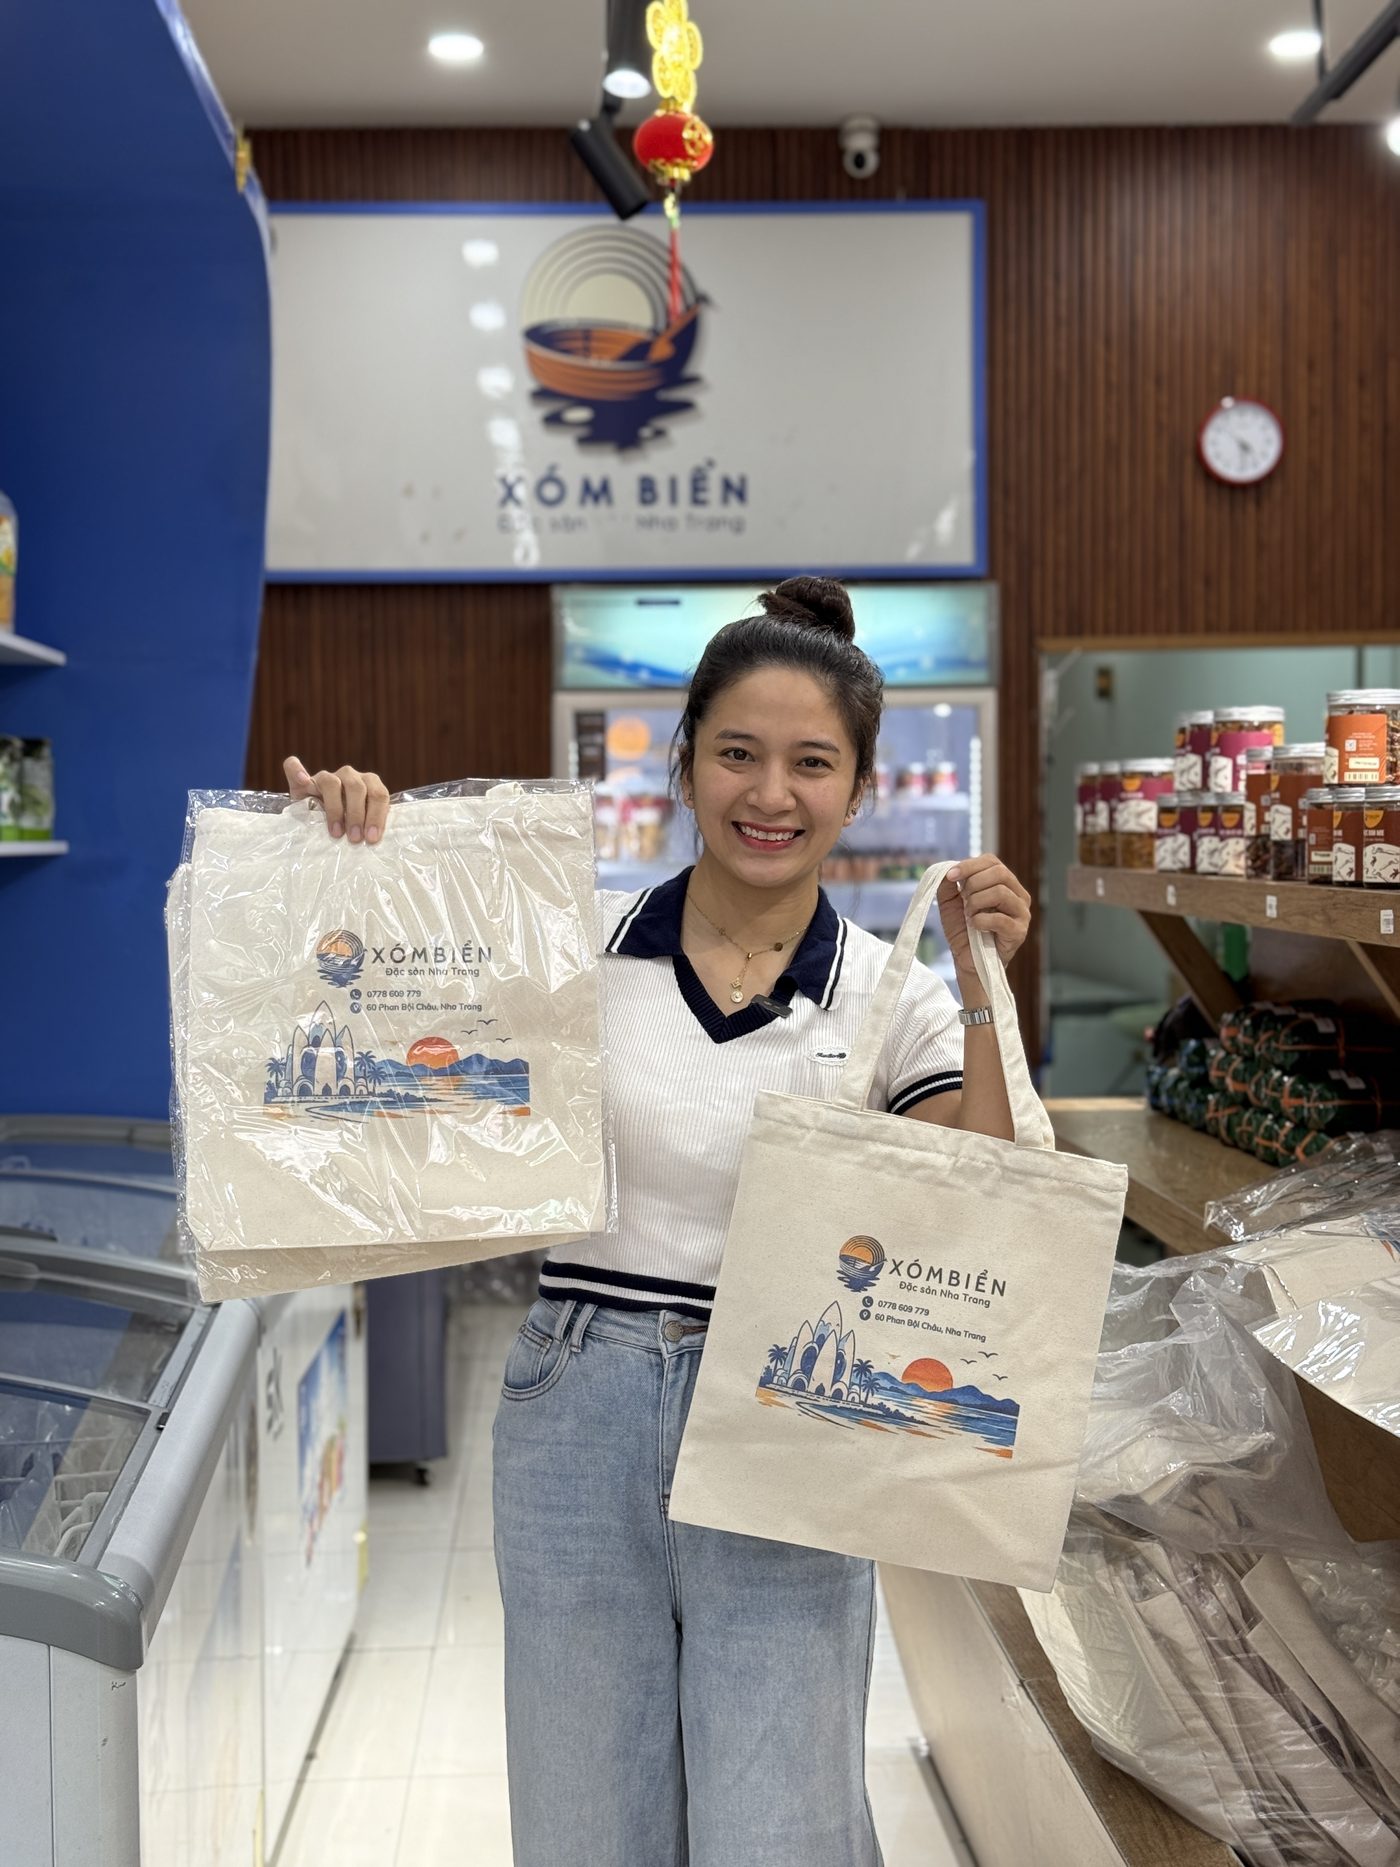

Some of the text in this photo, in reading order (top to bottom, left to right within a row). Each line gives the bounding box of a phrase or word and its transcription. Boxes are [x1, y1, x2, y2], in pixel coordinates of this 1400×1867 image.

[500, 457, 748, 507] XÓM BIỂN
[385, 967, 480, 977] Đặc sản Nha Trang
[366, 990, 388, 998] 0778
[406, 990, 422, 998] 779
[366, 1003, 377, 1011] 60
[378, 1003, 400, 1011] Phan
[440, 1003, 457, 1011] Nha
[459, 1003, 483, 1012] Trang
[899, 1280, 991, 1309] Đặc sản Nha Trang
[877, 1300, 930, 1317] 0778 609 779
[874, 1313, 987, 1343] 60 Phan Bội Châu, Nha Trang
